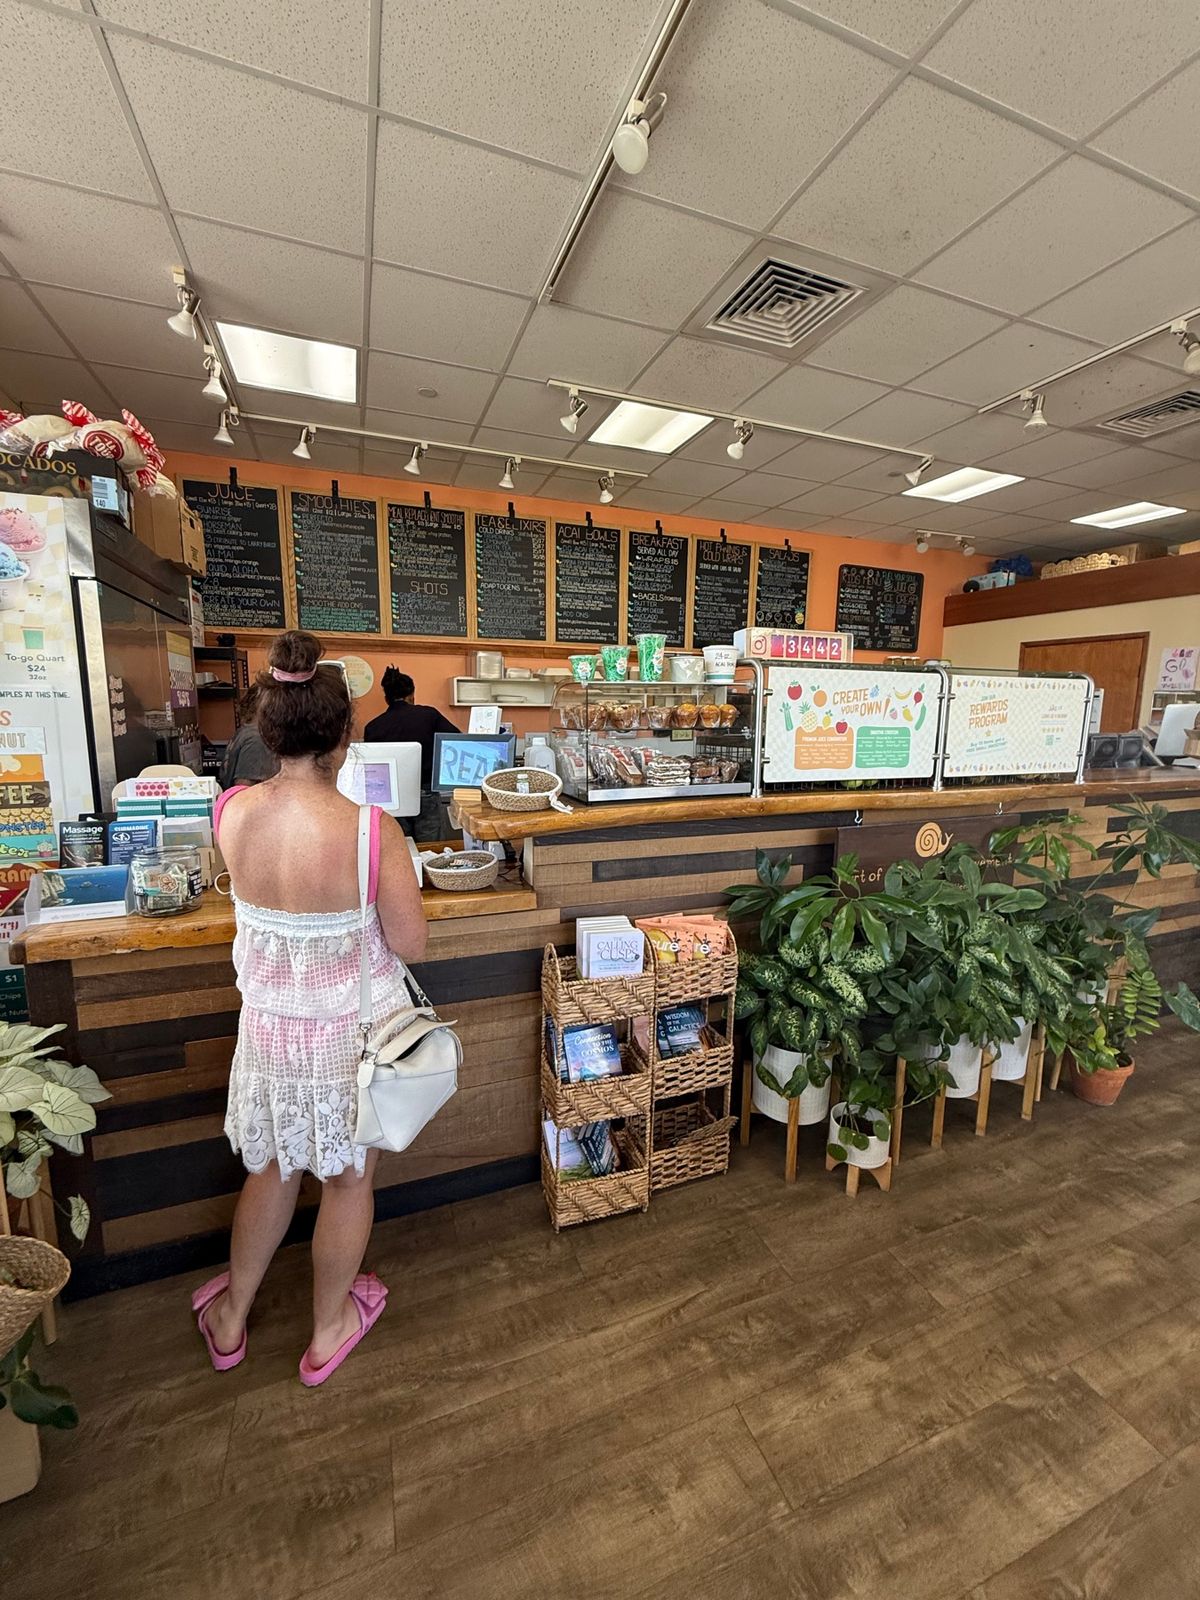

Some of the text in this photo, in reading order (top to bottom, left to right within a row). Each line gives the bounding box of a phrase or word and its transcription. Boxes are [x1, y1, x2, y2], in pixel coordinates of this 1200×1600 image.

[476, 514, 497, 527] TEA
[478, 526, 495, 534] COLD
[557, 526, 618, 543] ACAI BOWLS
[632, 533, 685, 550] BREAKFAST
[699, 540, 713, 551] HOT
[656, 548, 667, 556] ALL
[702, 550, 721, 562] COLD
[769, 549, 800, 562] SALADS
[410, 580, 448, 595] SHOTS
[480, 582, 520, 592] ADAPTOGENS
[259, 599, 281, 607] OWN
[637, 592, 664, 602] BAGELS
[5, 653, 34, 663] To-go
[832, 688, 870, 706] CREATE
[841, 700, 882, 717] YOUR OWN
[969, 699, 1009, 717] REWARDS
[968, 712, 1008, 730] PROGRAM
[62, 825, 103, 834] Massage
[868, 867, 882, 882] of
[597, 940, 638, 950] CALLING
[665, 1011, 690, 1020] WISDOM
[574, 1033, 612, 1045] Connection
[581, 1045, 615, 1058] COSMOS
